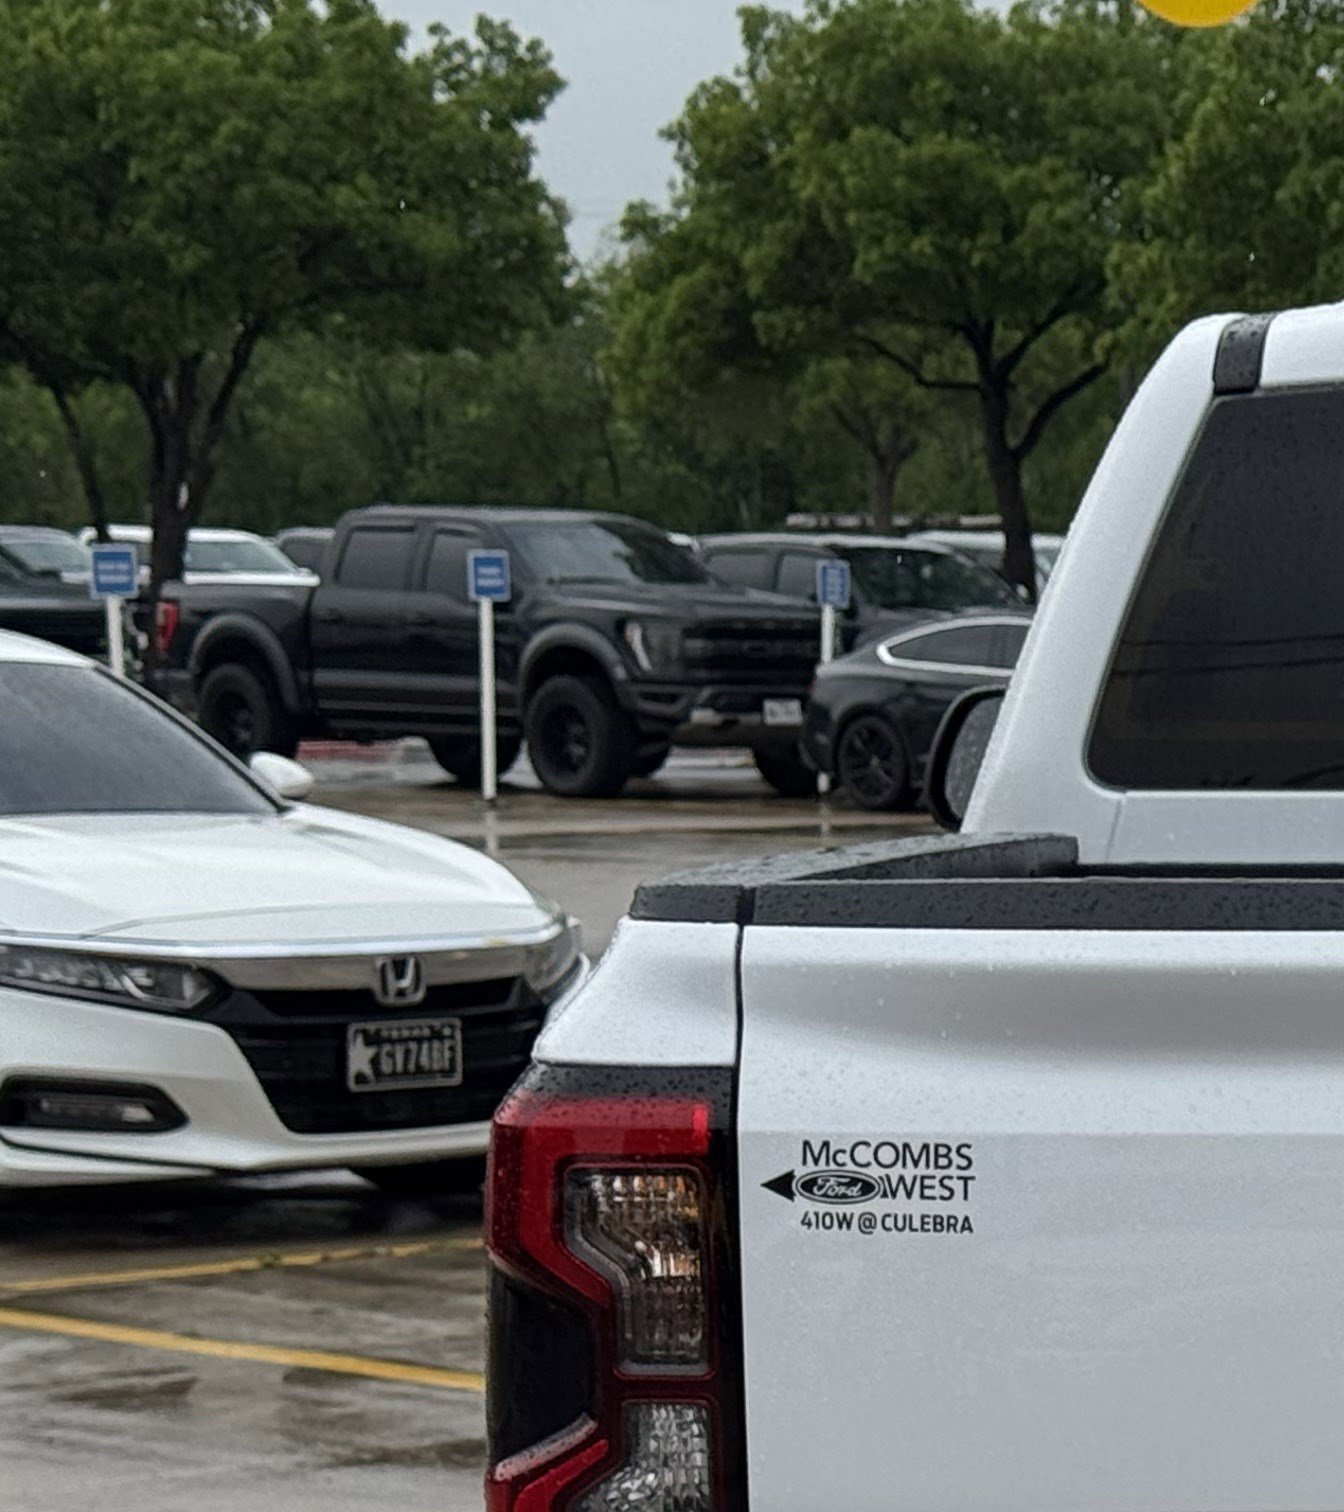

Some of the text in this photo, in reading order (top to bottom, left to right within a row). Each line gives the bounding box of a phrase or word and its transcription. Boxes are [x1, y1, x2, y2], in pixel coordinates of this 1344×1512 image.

[801, 1140, 973, 1171] McCOMBS
[812, 1174, 976, 1201] Ford WEST
